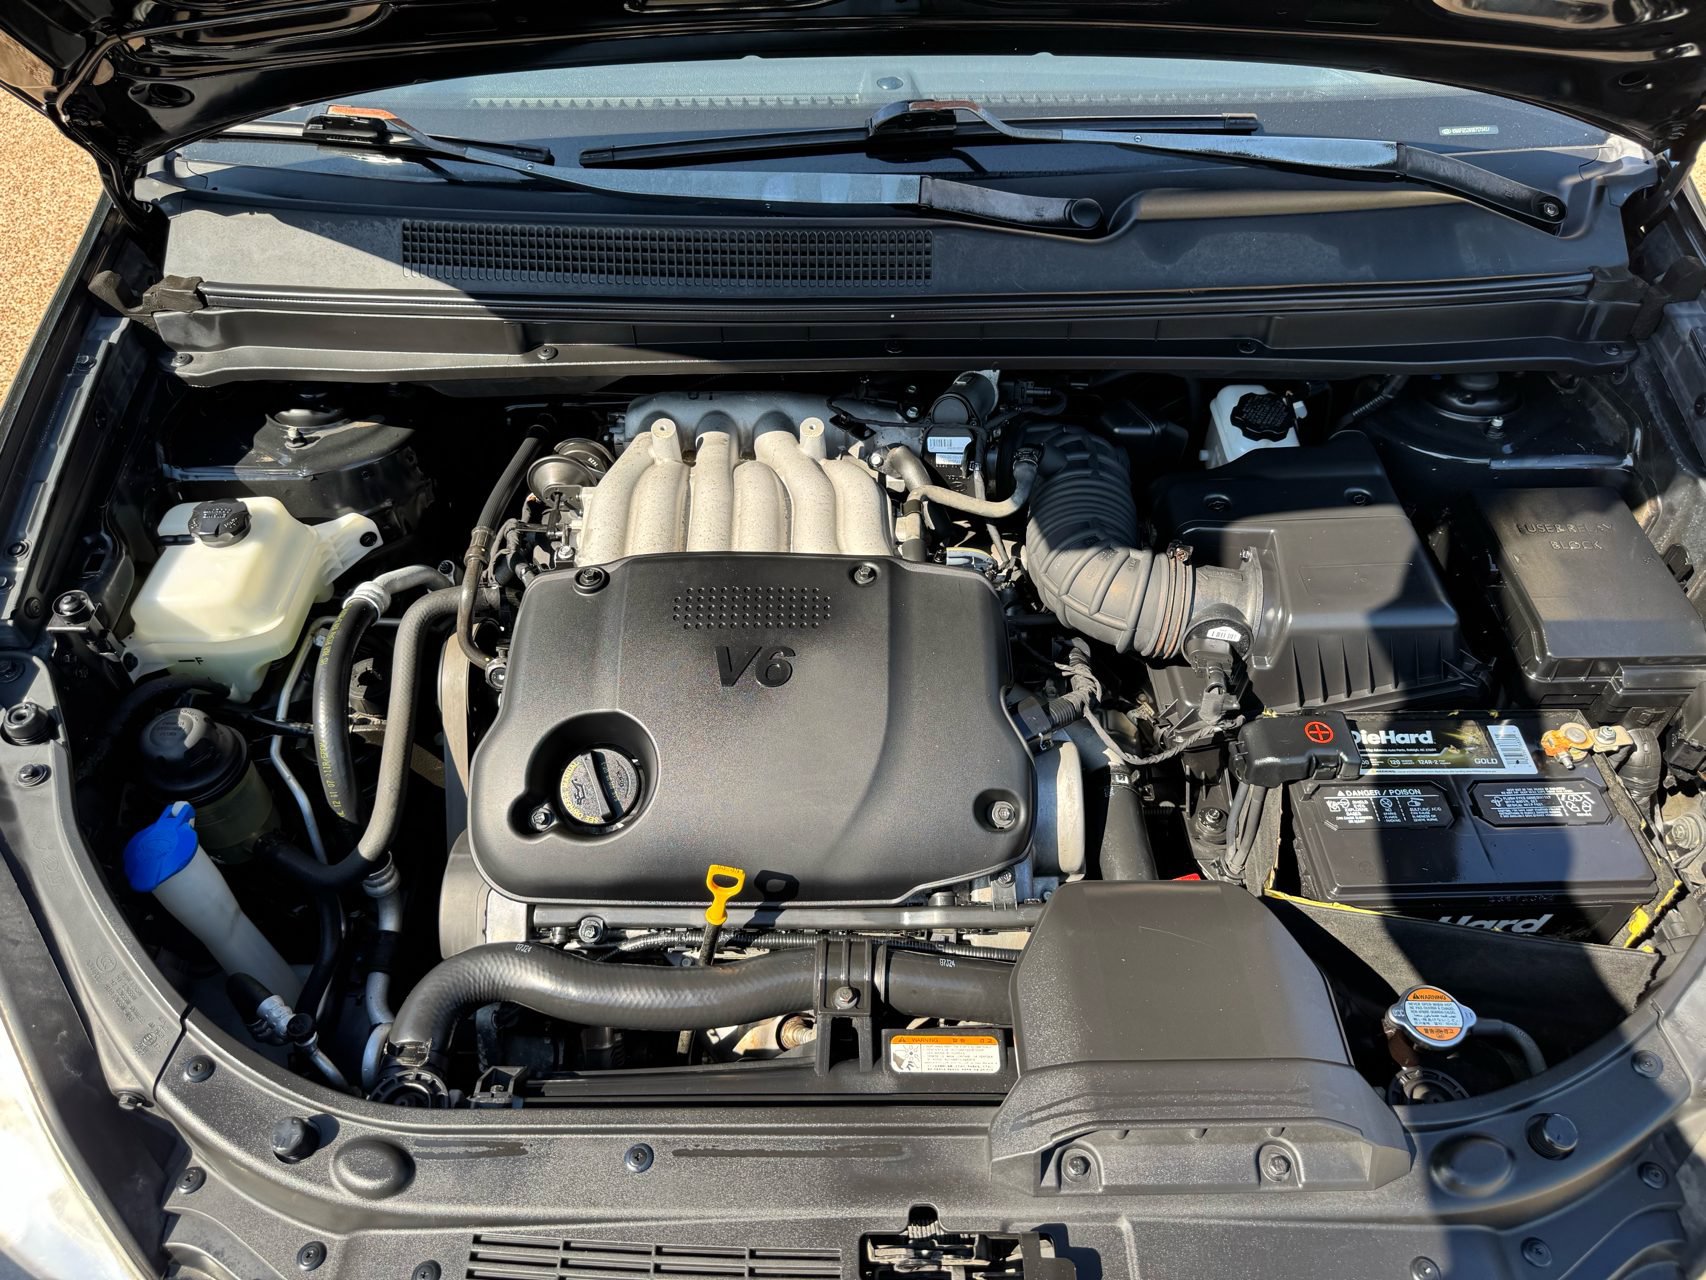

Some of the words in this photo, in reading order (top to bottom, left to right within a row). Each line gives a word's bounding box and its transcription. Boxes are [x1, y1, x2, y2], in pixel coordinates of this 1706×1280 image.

[1550, 540, 1602, 550] BLOCK
[715, 646, 796, 688] V6
[1474, 757, 1498, 765] GOLD
[1345, 789, 1381, 797] DANGER
[1389, 788, 1422, 796] POISON
